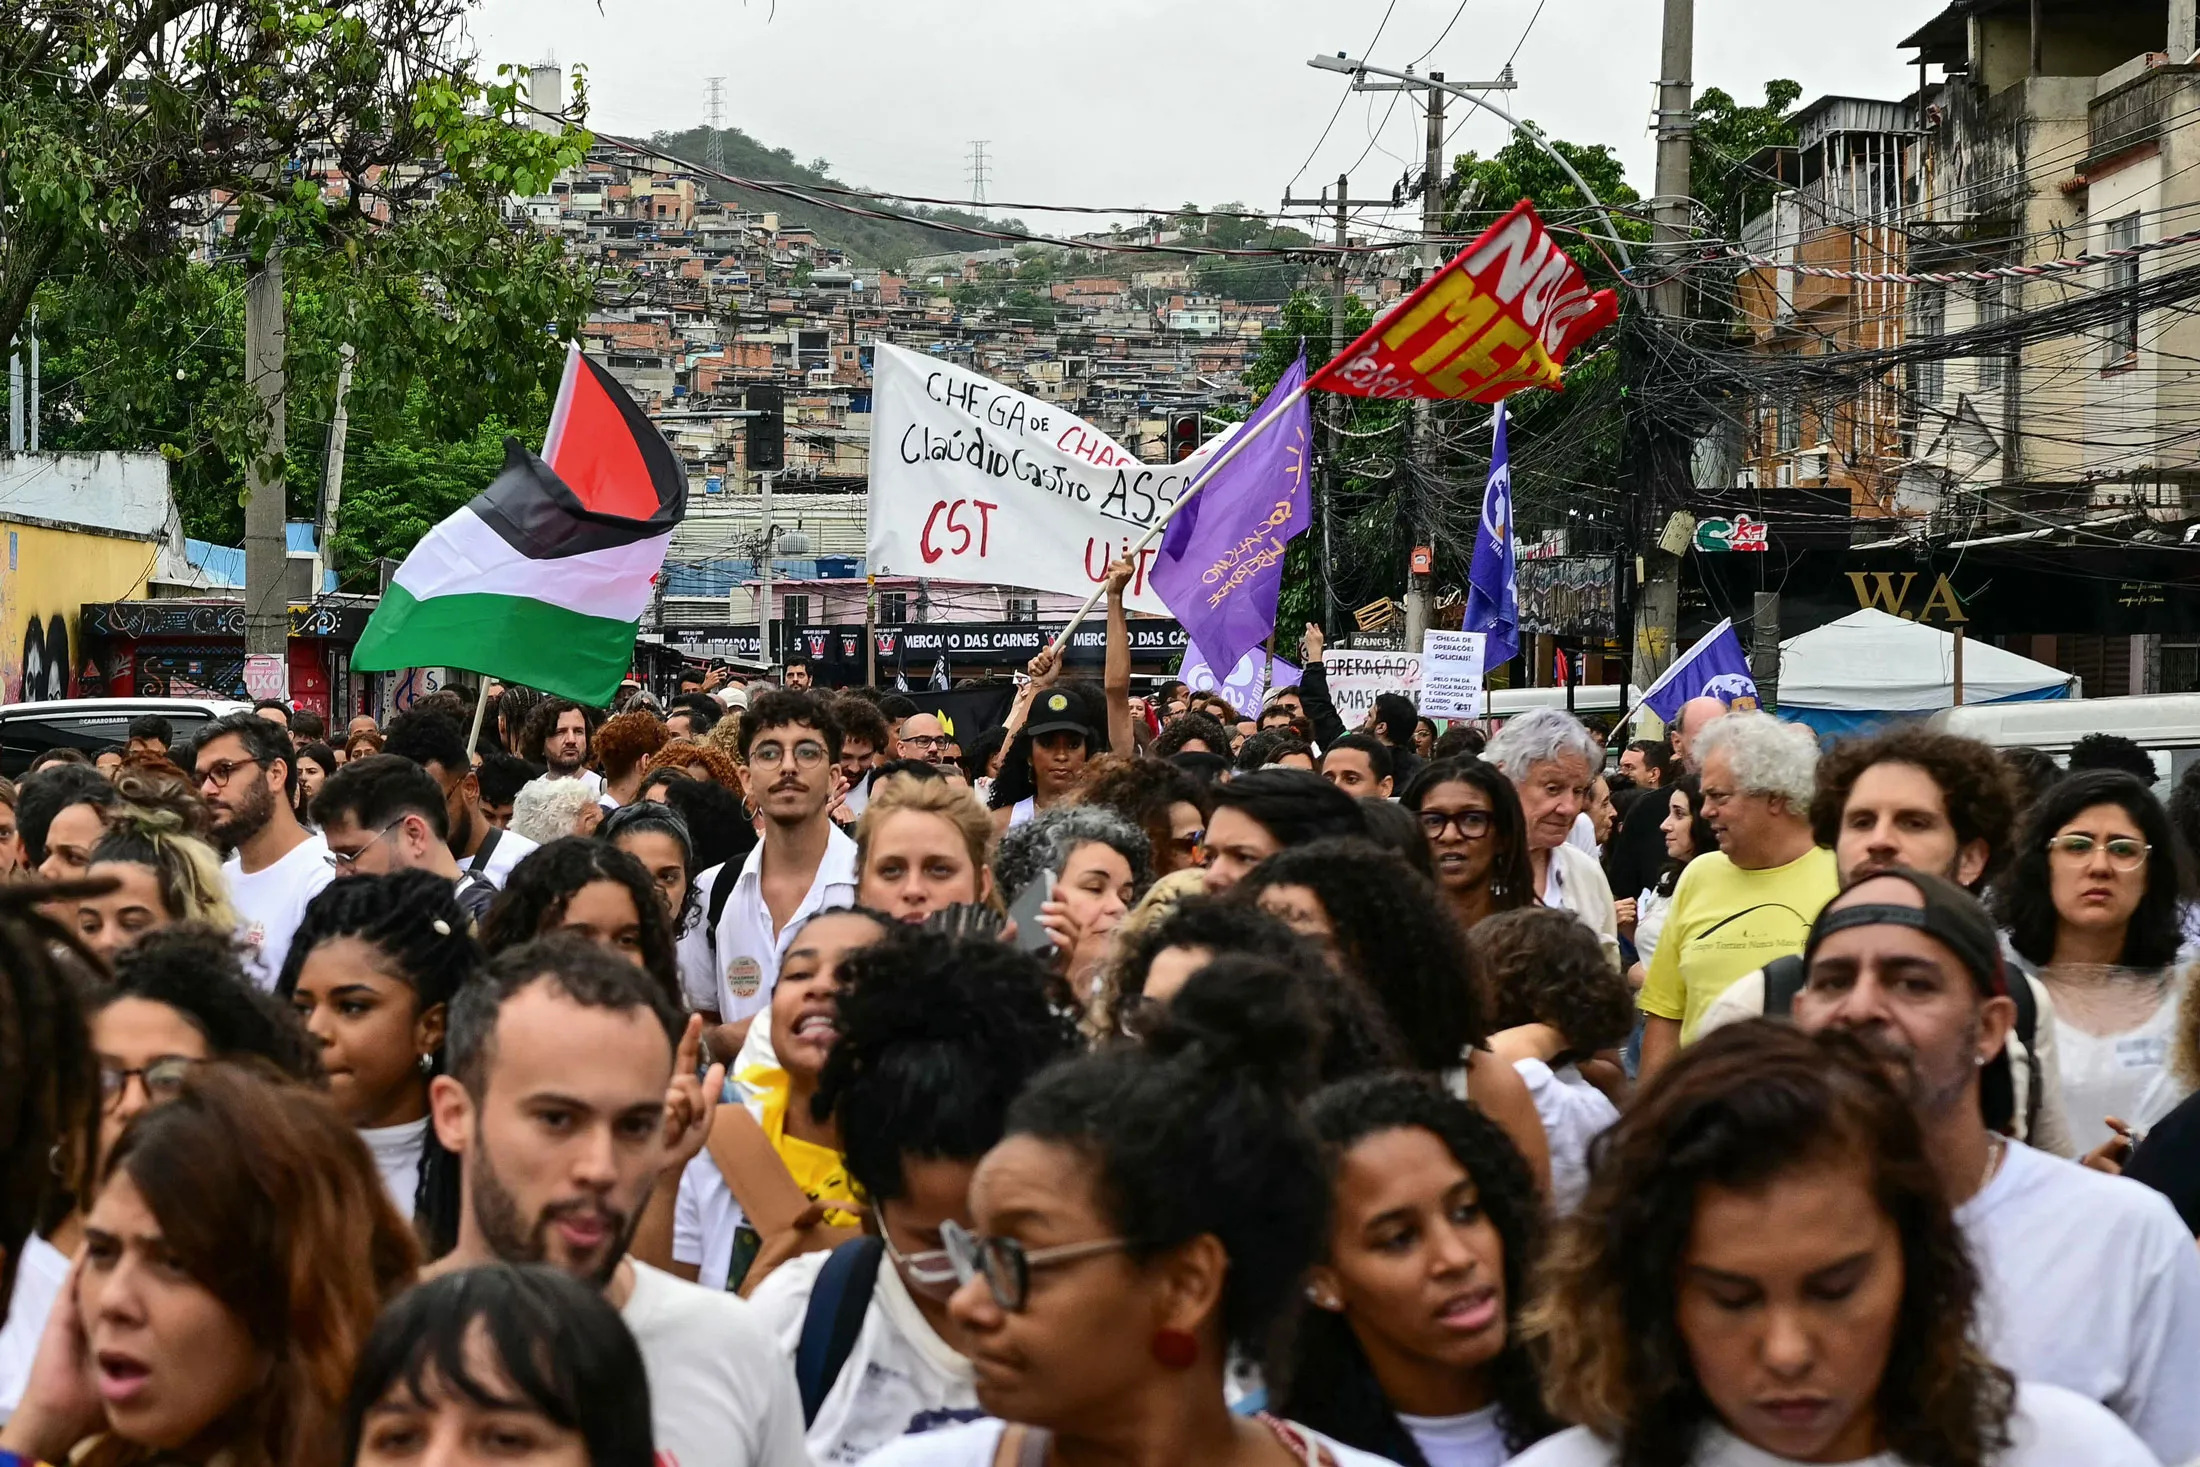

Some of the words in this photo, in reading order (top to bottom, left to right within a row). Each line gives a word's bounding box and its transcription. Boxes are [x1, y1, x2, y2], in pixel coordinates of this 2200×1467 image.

[926, 372, 1025, 435] CHEGA
[1030, 417, 1050, 432] DE
[920, 499, 998, 564] CST
[964, 634, 989, 648] DAS
[994, 633, 1040, 647] CARNES
[1138, 631, 1164, 646] DAS
